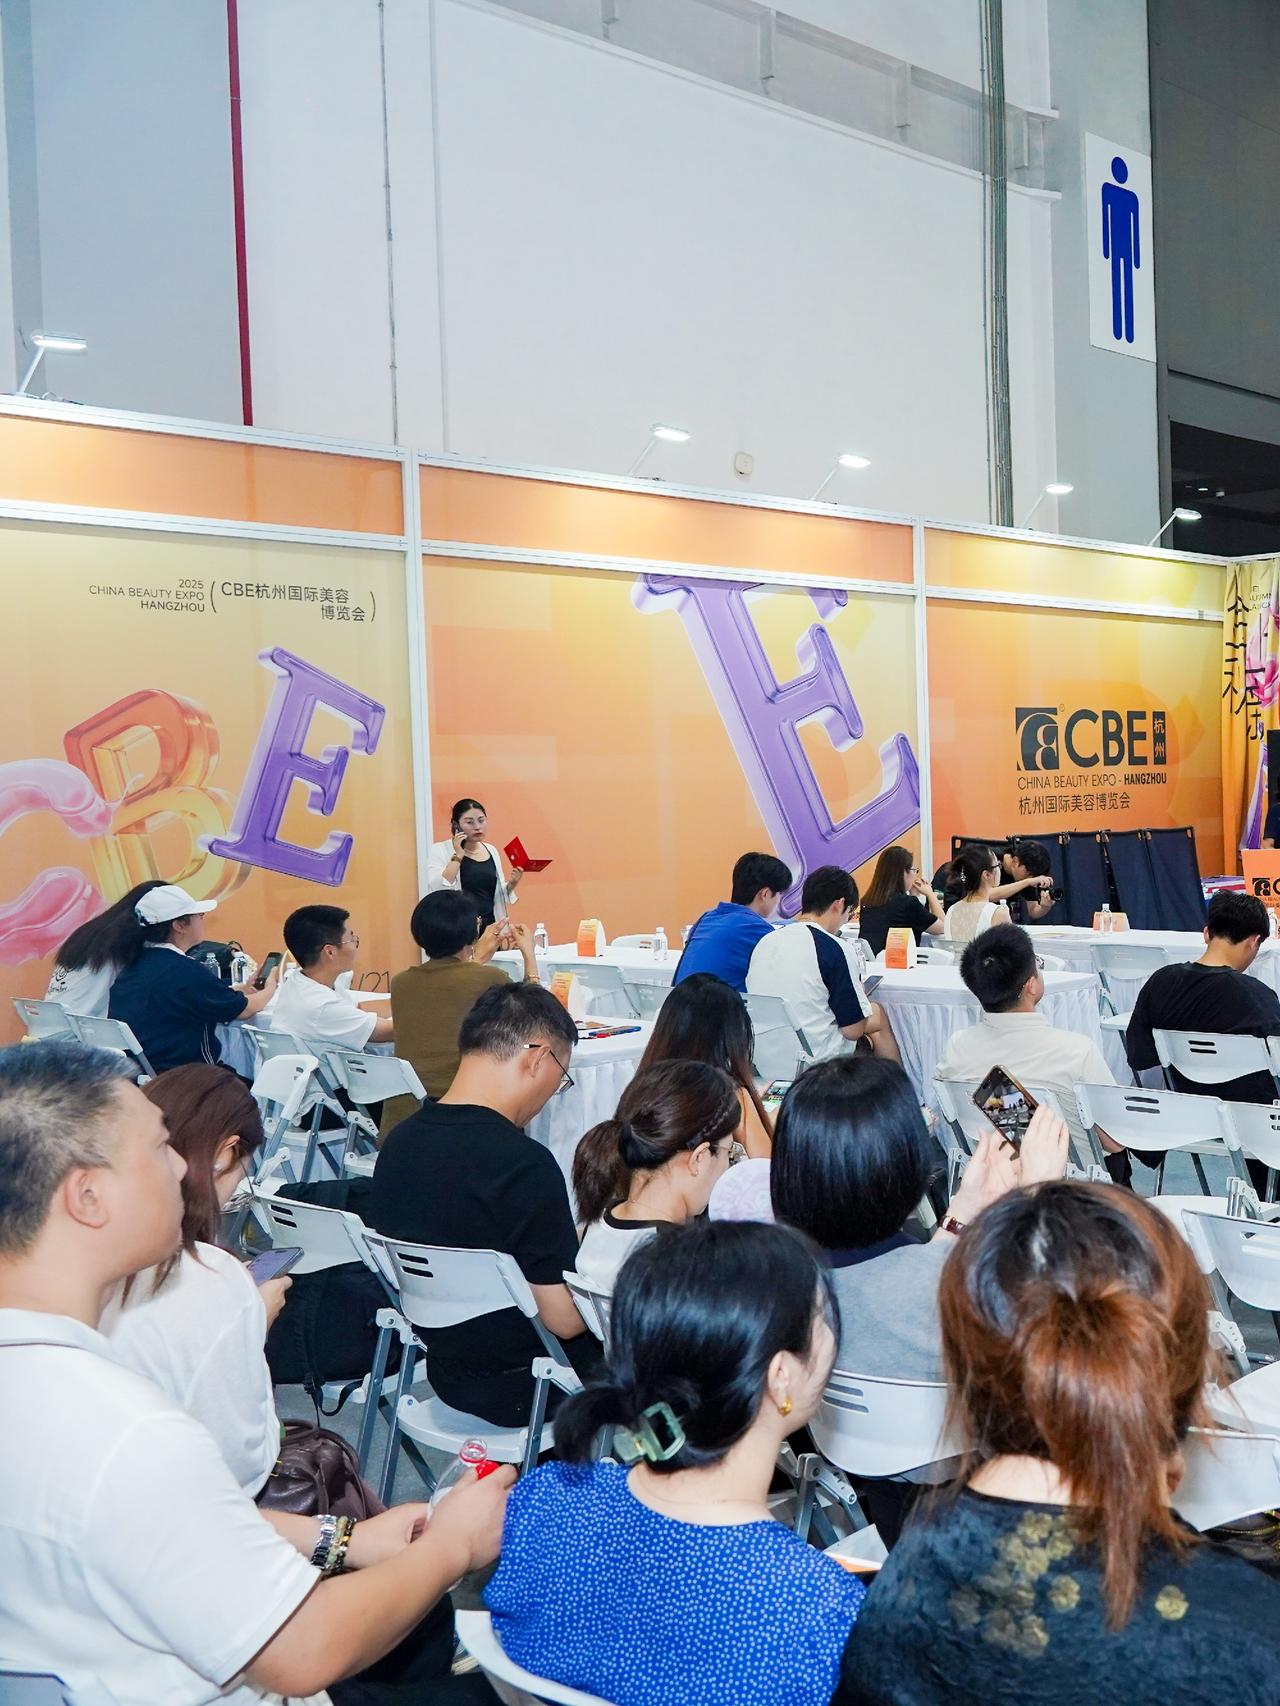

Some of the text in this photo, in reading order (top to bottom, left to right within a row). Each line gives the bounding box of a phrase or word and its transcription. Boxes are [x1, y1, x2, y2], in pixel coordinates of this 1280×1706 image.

[89, 585, 205, 601] CHINA BEAUTY EXPO
[179, 579, 204, 589] 2025
[141, 600, 205, 612] HANGZHOU
[1064, 708, 1148, 769] CBE
[1154, 717, 1165, 760] 杭州
[1017, 776, 1051, 791] CHINA
[1054, 774, 1090, 789] BEAUTY
[1092, 773, 1117, 787] EXPO
[1124, 772, 1167, 785] HANGZHOU
[1019, 792, 1130, 815] 杭州国际美容博览会
